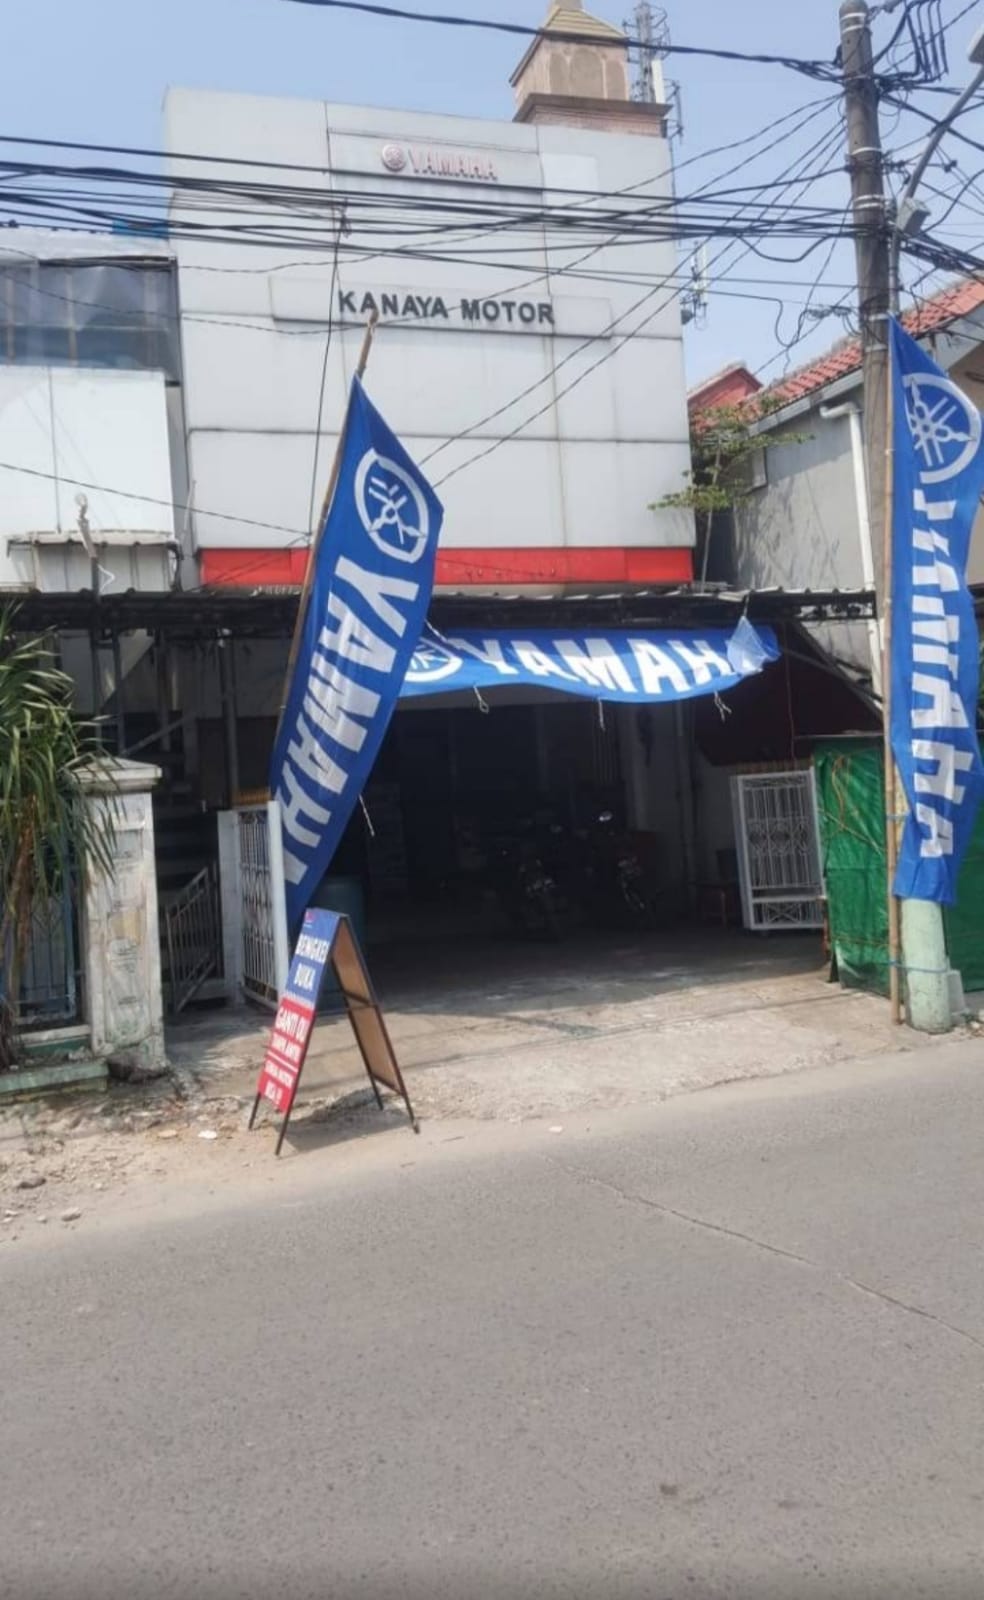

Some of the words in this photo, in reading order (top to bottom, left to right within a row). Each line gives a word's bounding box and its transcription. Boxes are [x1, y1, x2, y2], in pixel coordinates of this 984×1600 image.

[407, 148, 498, 182] YAMAHA
[338, 290, 448, 319] KANAYA
[460, 298, 555, 325] MOTOR
